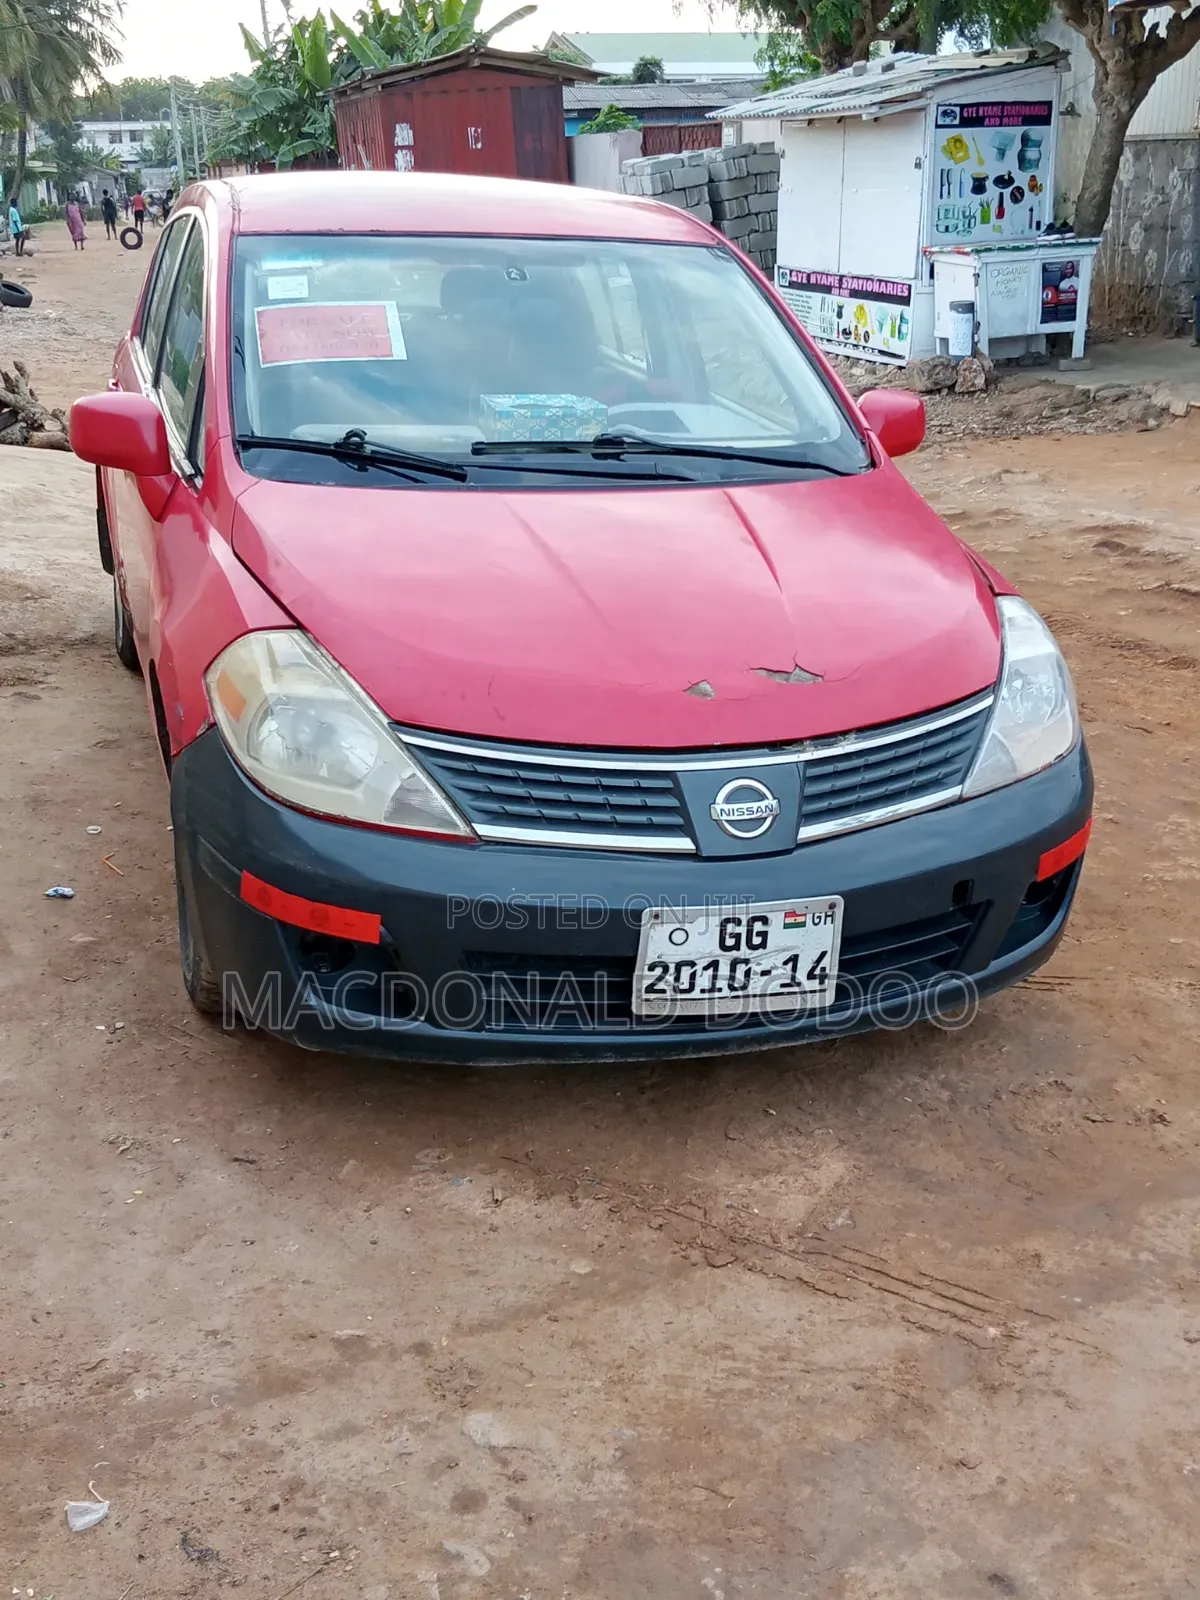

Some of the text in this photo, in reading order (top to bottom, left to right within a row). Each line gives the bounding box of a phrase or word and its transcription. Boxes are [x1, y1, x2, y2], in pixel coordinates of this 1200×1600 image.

[963, 106, 977, 117] GYE
[979, 105, 1002, 117] NYAME
[984, 117, 1023, 126] AND MORE
[990, 266, 1029, 279] ORGANIC
[791, 270, 909, 297] GYE NYAME STATIONARIES
[995, 275, 1022, 287] HONEY
[720, 804, 774, 817] NISSAN
[718, 915, 770, 952] GG
[644, 950, 830, 995] 2010-14
